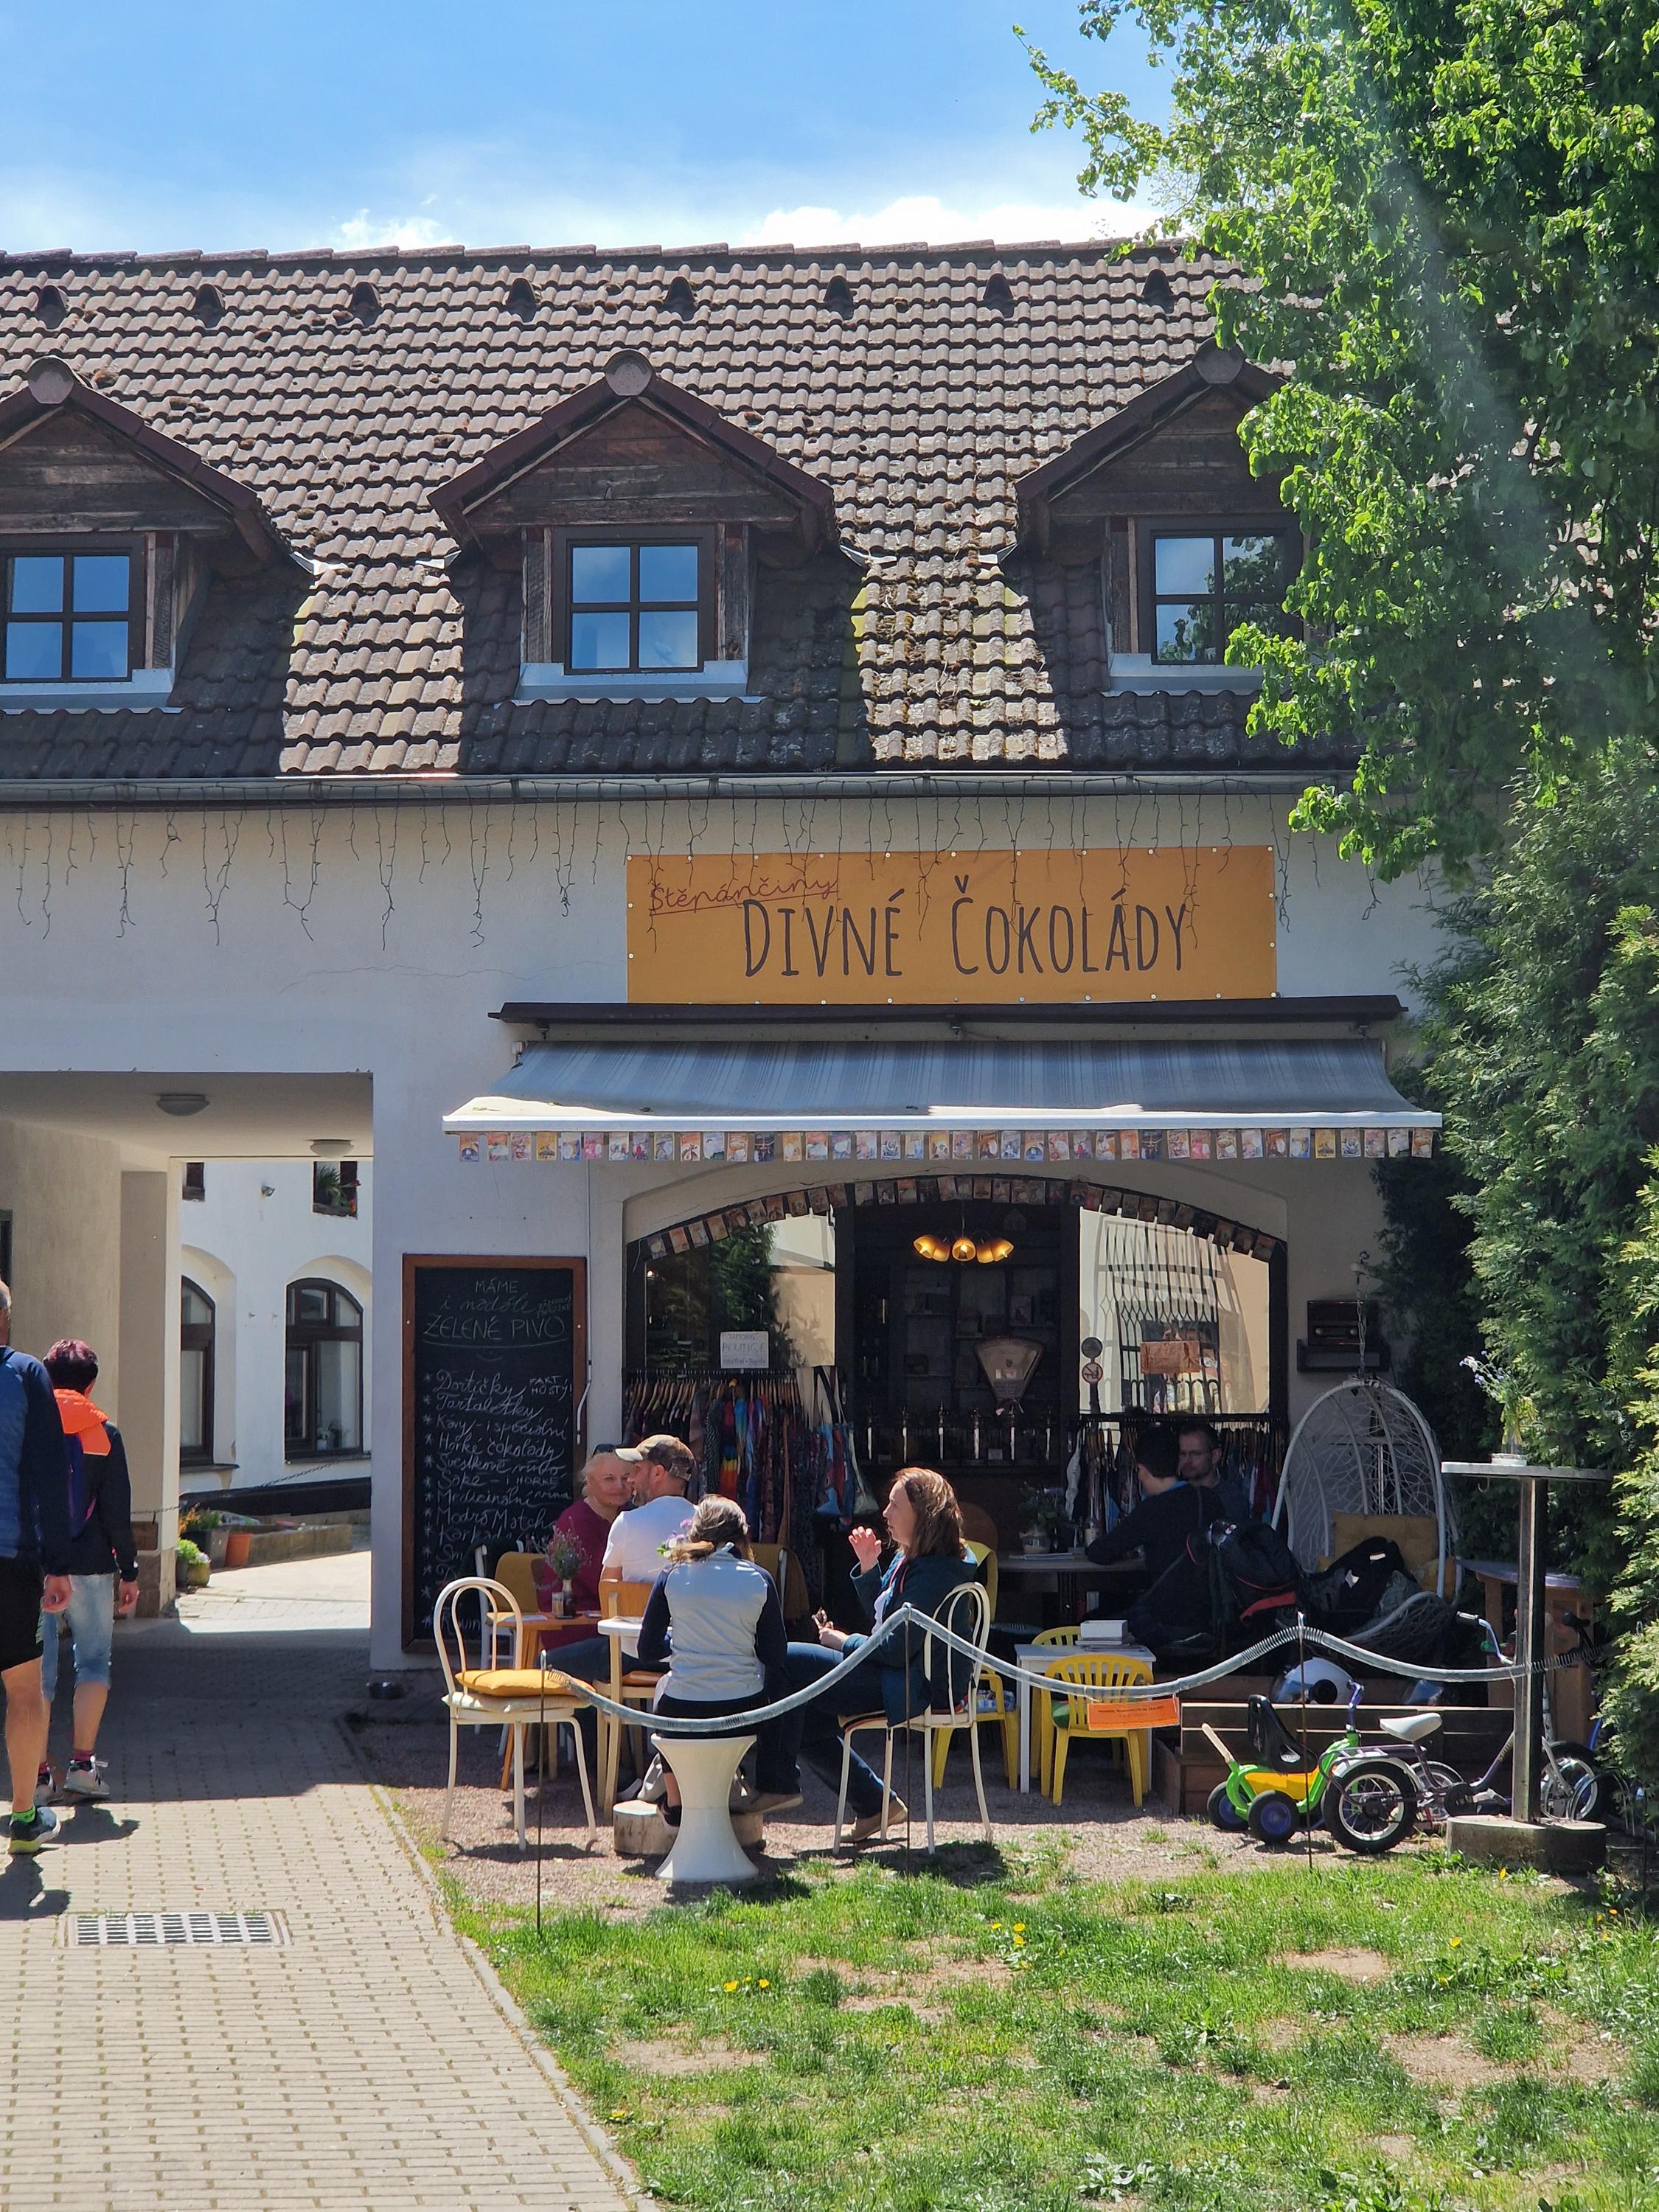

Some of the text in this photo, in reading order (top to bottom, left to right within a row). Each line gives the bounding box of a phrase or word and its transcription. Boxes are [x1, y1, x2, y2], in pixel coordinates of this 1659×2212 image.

[650, 877, 838, 914] Štěpánčiny
[742, 874, 1189, 978] DIVNÉ ČOKOLÁDY
[475, 1277, 518, 1294] MÁME
[422, 1313, 566, 1340] ZELENÉ PIVO
[529, 1375, 563, 1386] FAKT
